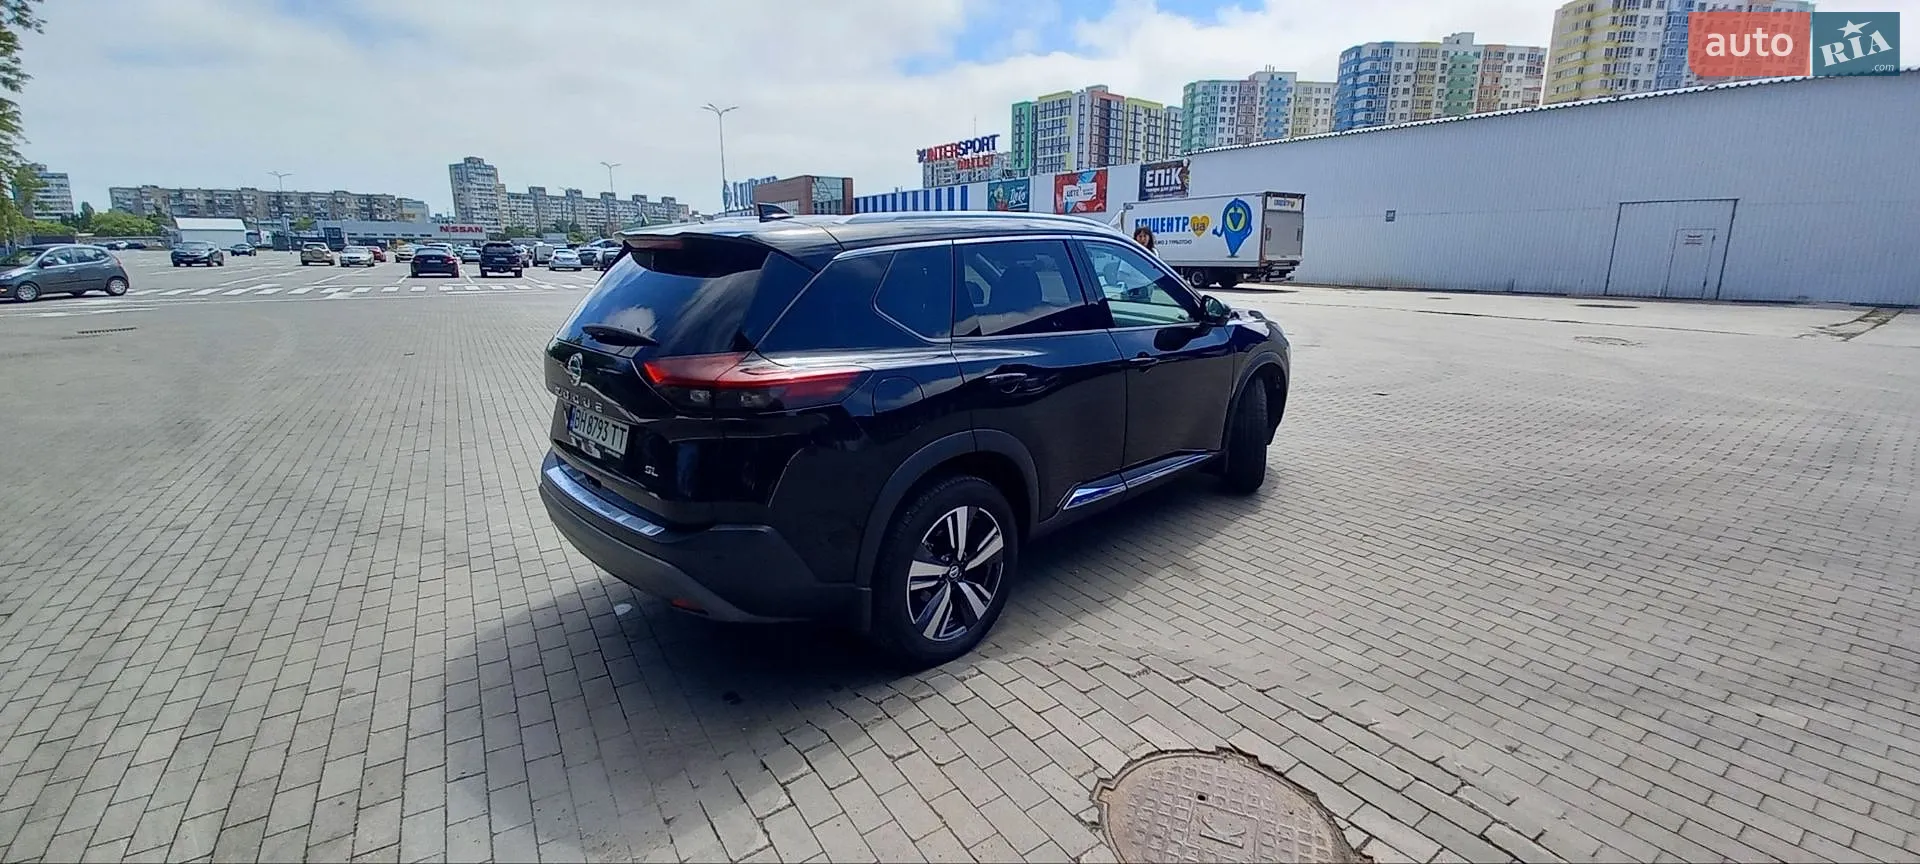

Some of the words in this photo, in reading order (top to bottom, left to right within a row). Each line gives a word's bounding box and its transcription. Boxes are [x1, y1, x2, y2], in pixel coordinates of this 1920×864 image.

[926, 133, 1000, 164] INTERSPORT
[957, 153, 996, 171] OUTLET
[439, 225, 483, 234] NISSAN
[587, 415, 608, 442] 8793
[611, 424, 628, 450] TT
[644, 465, 659, 477] SL
